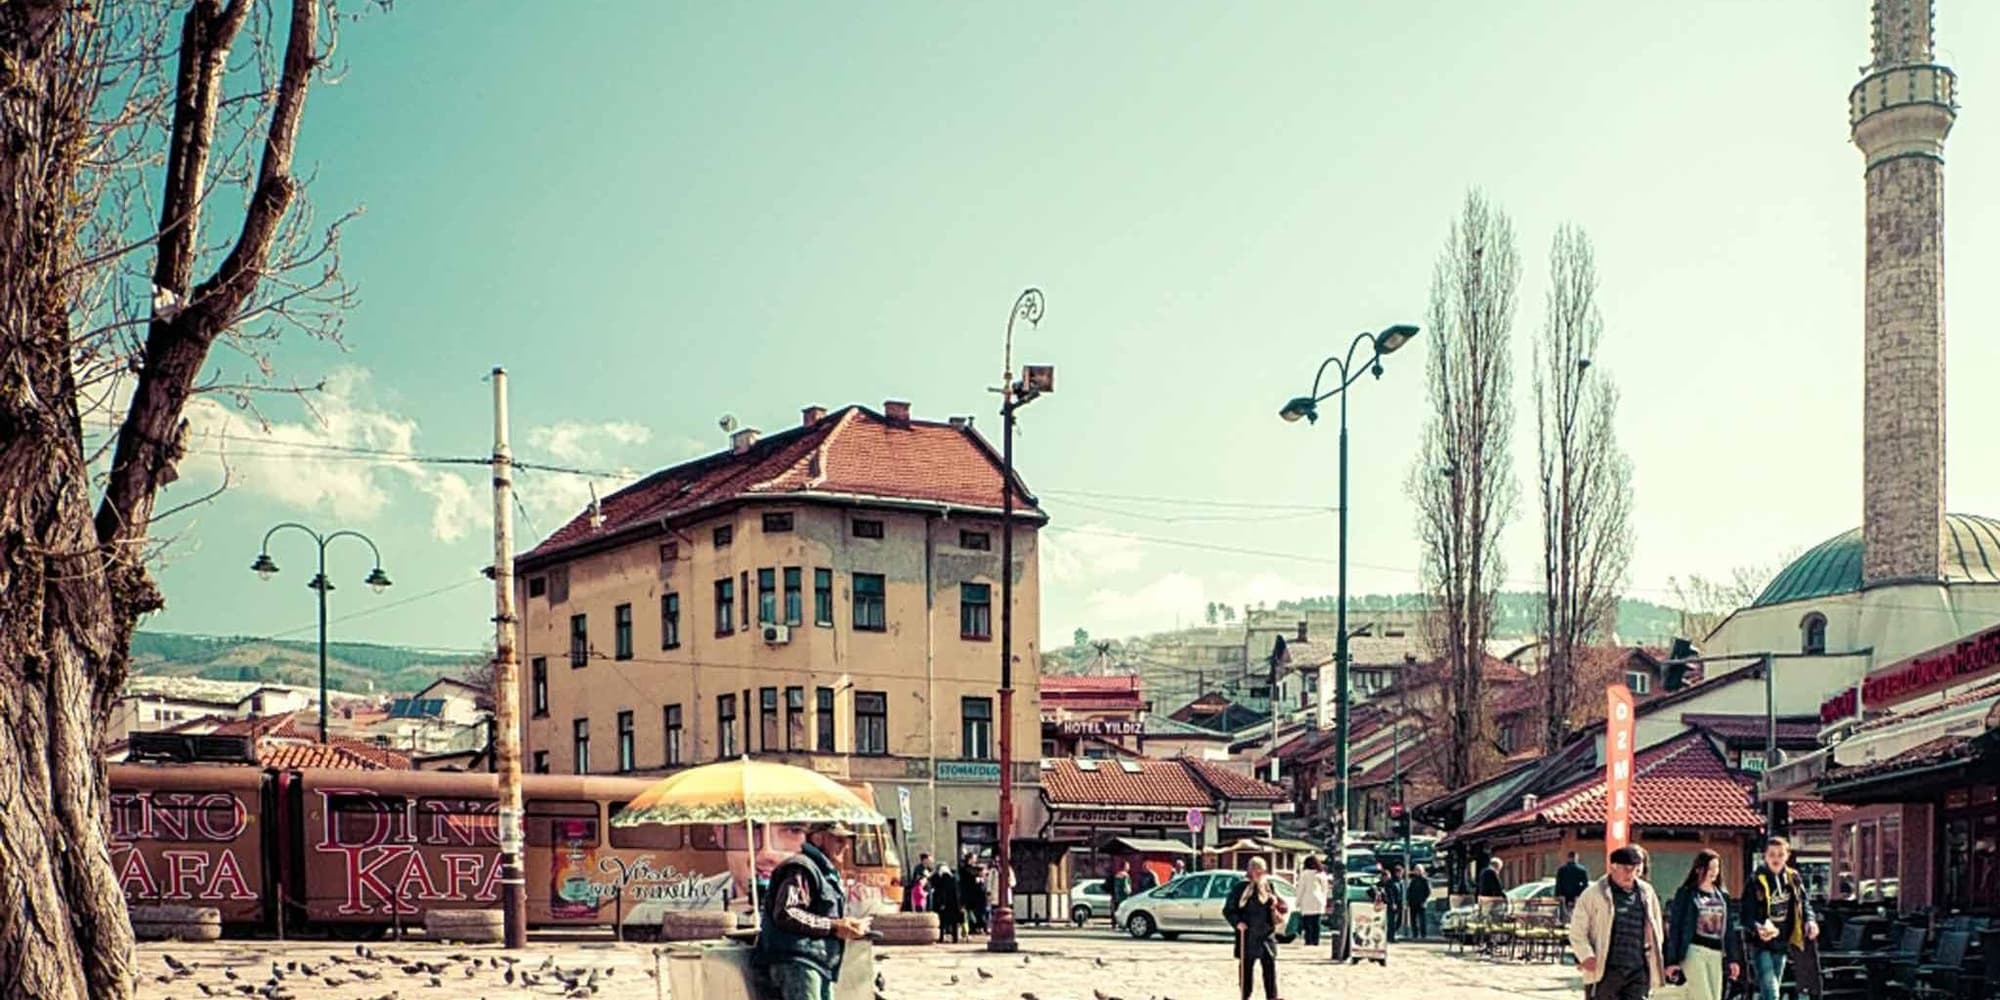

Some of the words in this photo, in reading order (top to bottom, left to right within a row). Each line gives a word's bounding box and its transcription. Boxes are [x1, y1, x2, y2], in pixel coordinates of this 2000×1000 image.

[1064, 721, 1101, 734] HOTEL
[111, 793, 248, 841] INO
[108, 842, 258, 899] AFA
